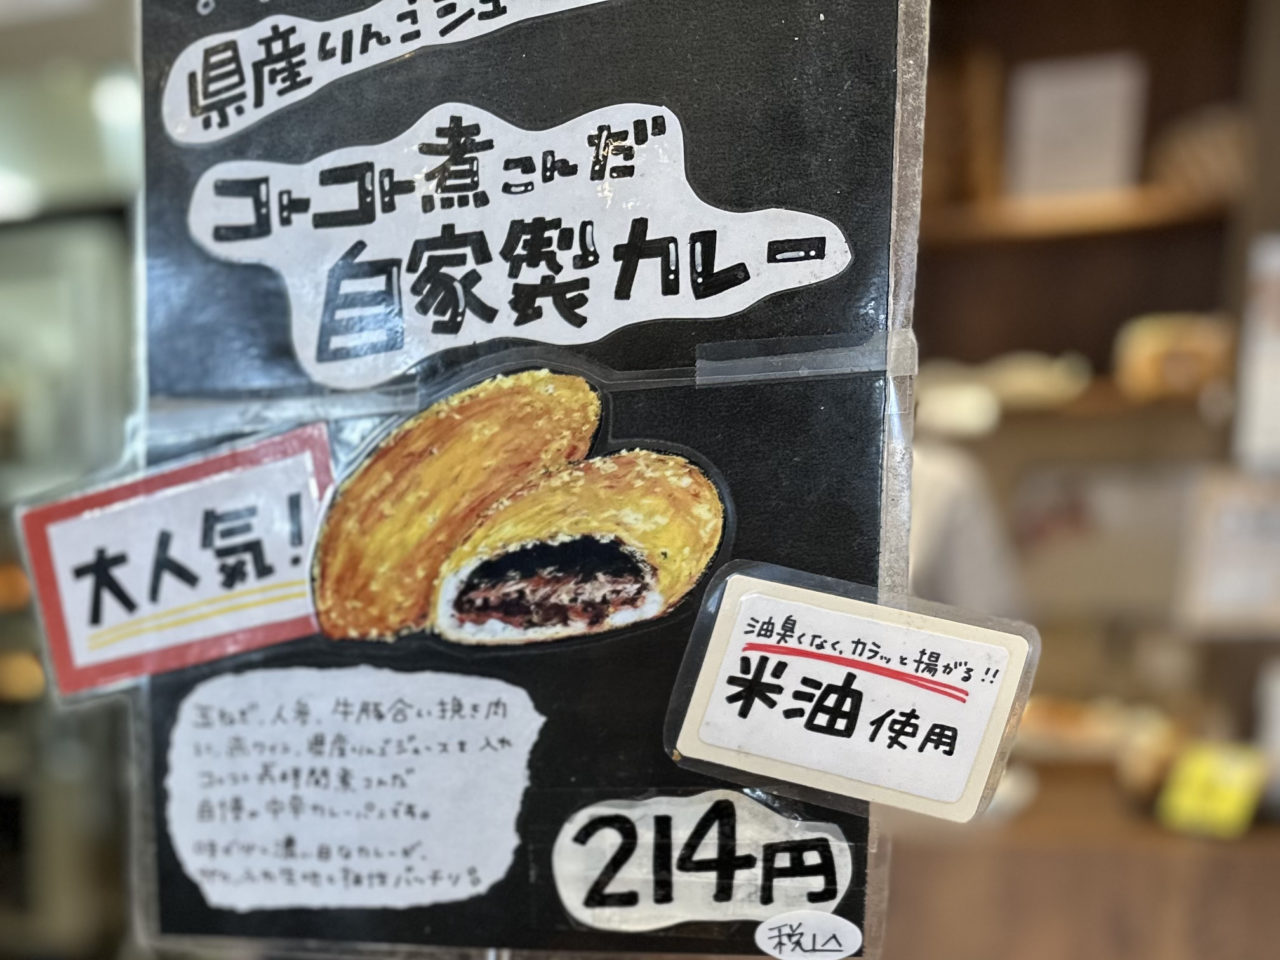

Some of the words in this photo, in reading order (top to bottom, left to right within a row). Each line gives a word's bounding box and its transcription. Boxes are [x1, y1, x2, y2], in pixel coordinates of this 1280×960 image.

[213, 115, 666, 242] コトコト煮こんだ
[317, 216, 826, 363] 自家製カレー
[73, 492, 303, 625] 大人気!
[572, 799, 838, 908] 214円
[768, 922, 843, 953] 税込
